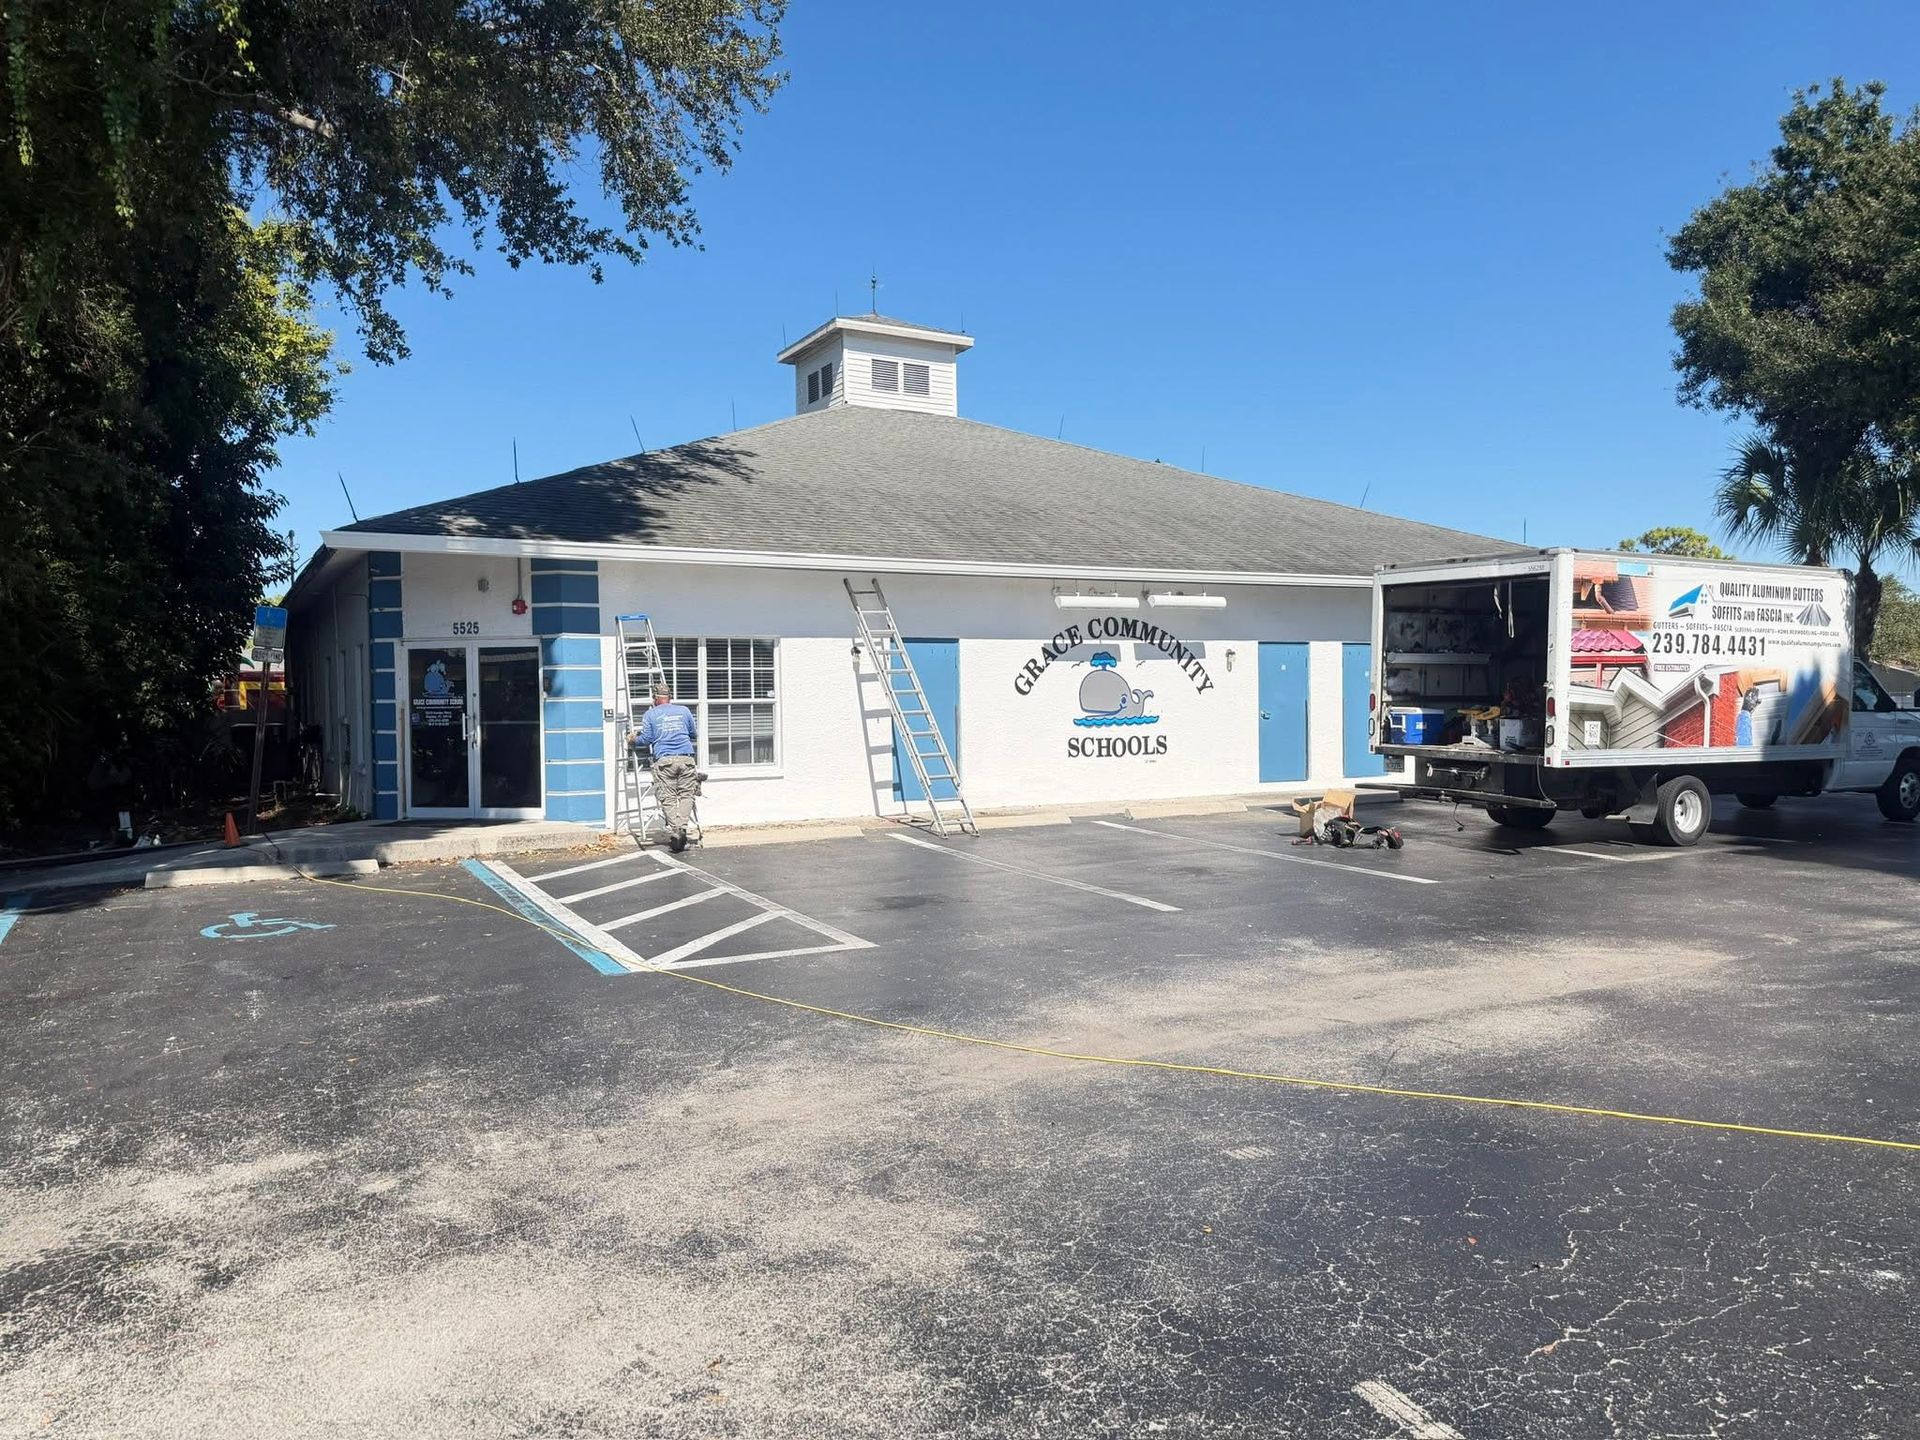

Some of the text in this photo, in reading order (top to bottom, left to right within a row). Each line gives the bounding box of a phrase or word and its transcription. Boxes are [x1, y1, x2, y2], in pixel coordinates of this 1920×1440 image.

[1720, 582, 1824, 602] QUALITY ALUMINUM GUTTERS
[1712, 605, 1742, 621] SOFFITS
[1743, 610, 1755, 621] AND
[1757, 608, 1782, 622] FASCIA
[453, 622, 480, 635] 5525
[1653, 621, 1679, 630] GUTTERS
[1714, 624, 1732, 632] FASCIA
[1652, 632, 1765, 656] 239.784.4431
[1014, 617, 1214, 696] GRACE COMMUNITY
[1067, 735, 1168, 758] SCHOOLS
